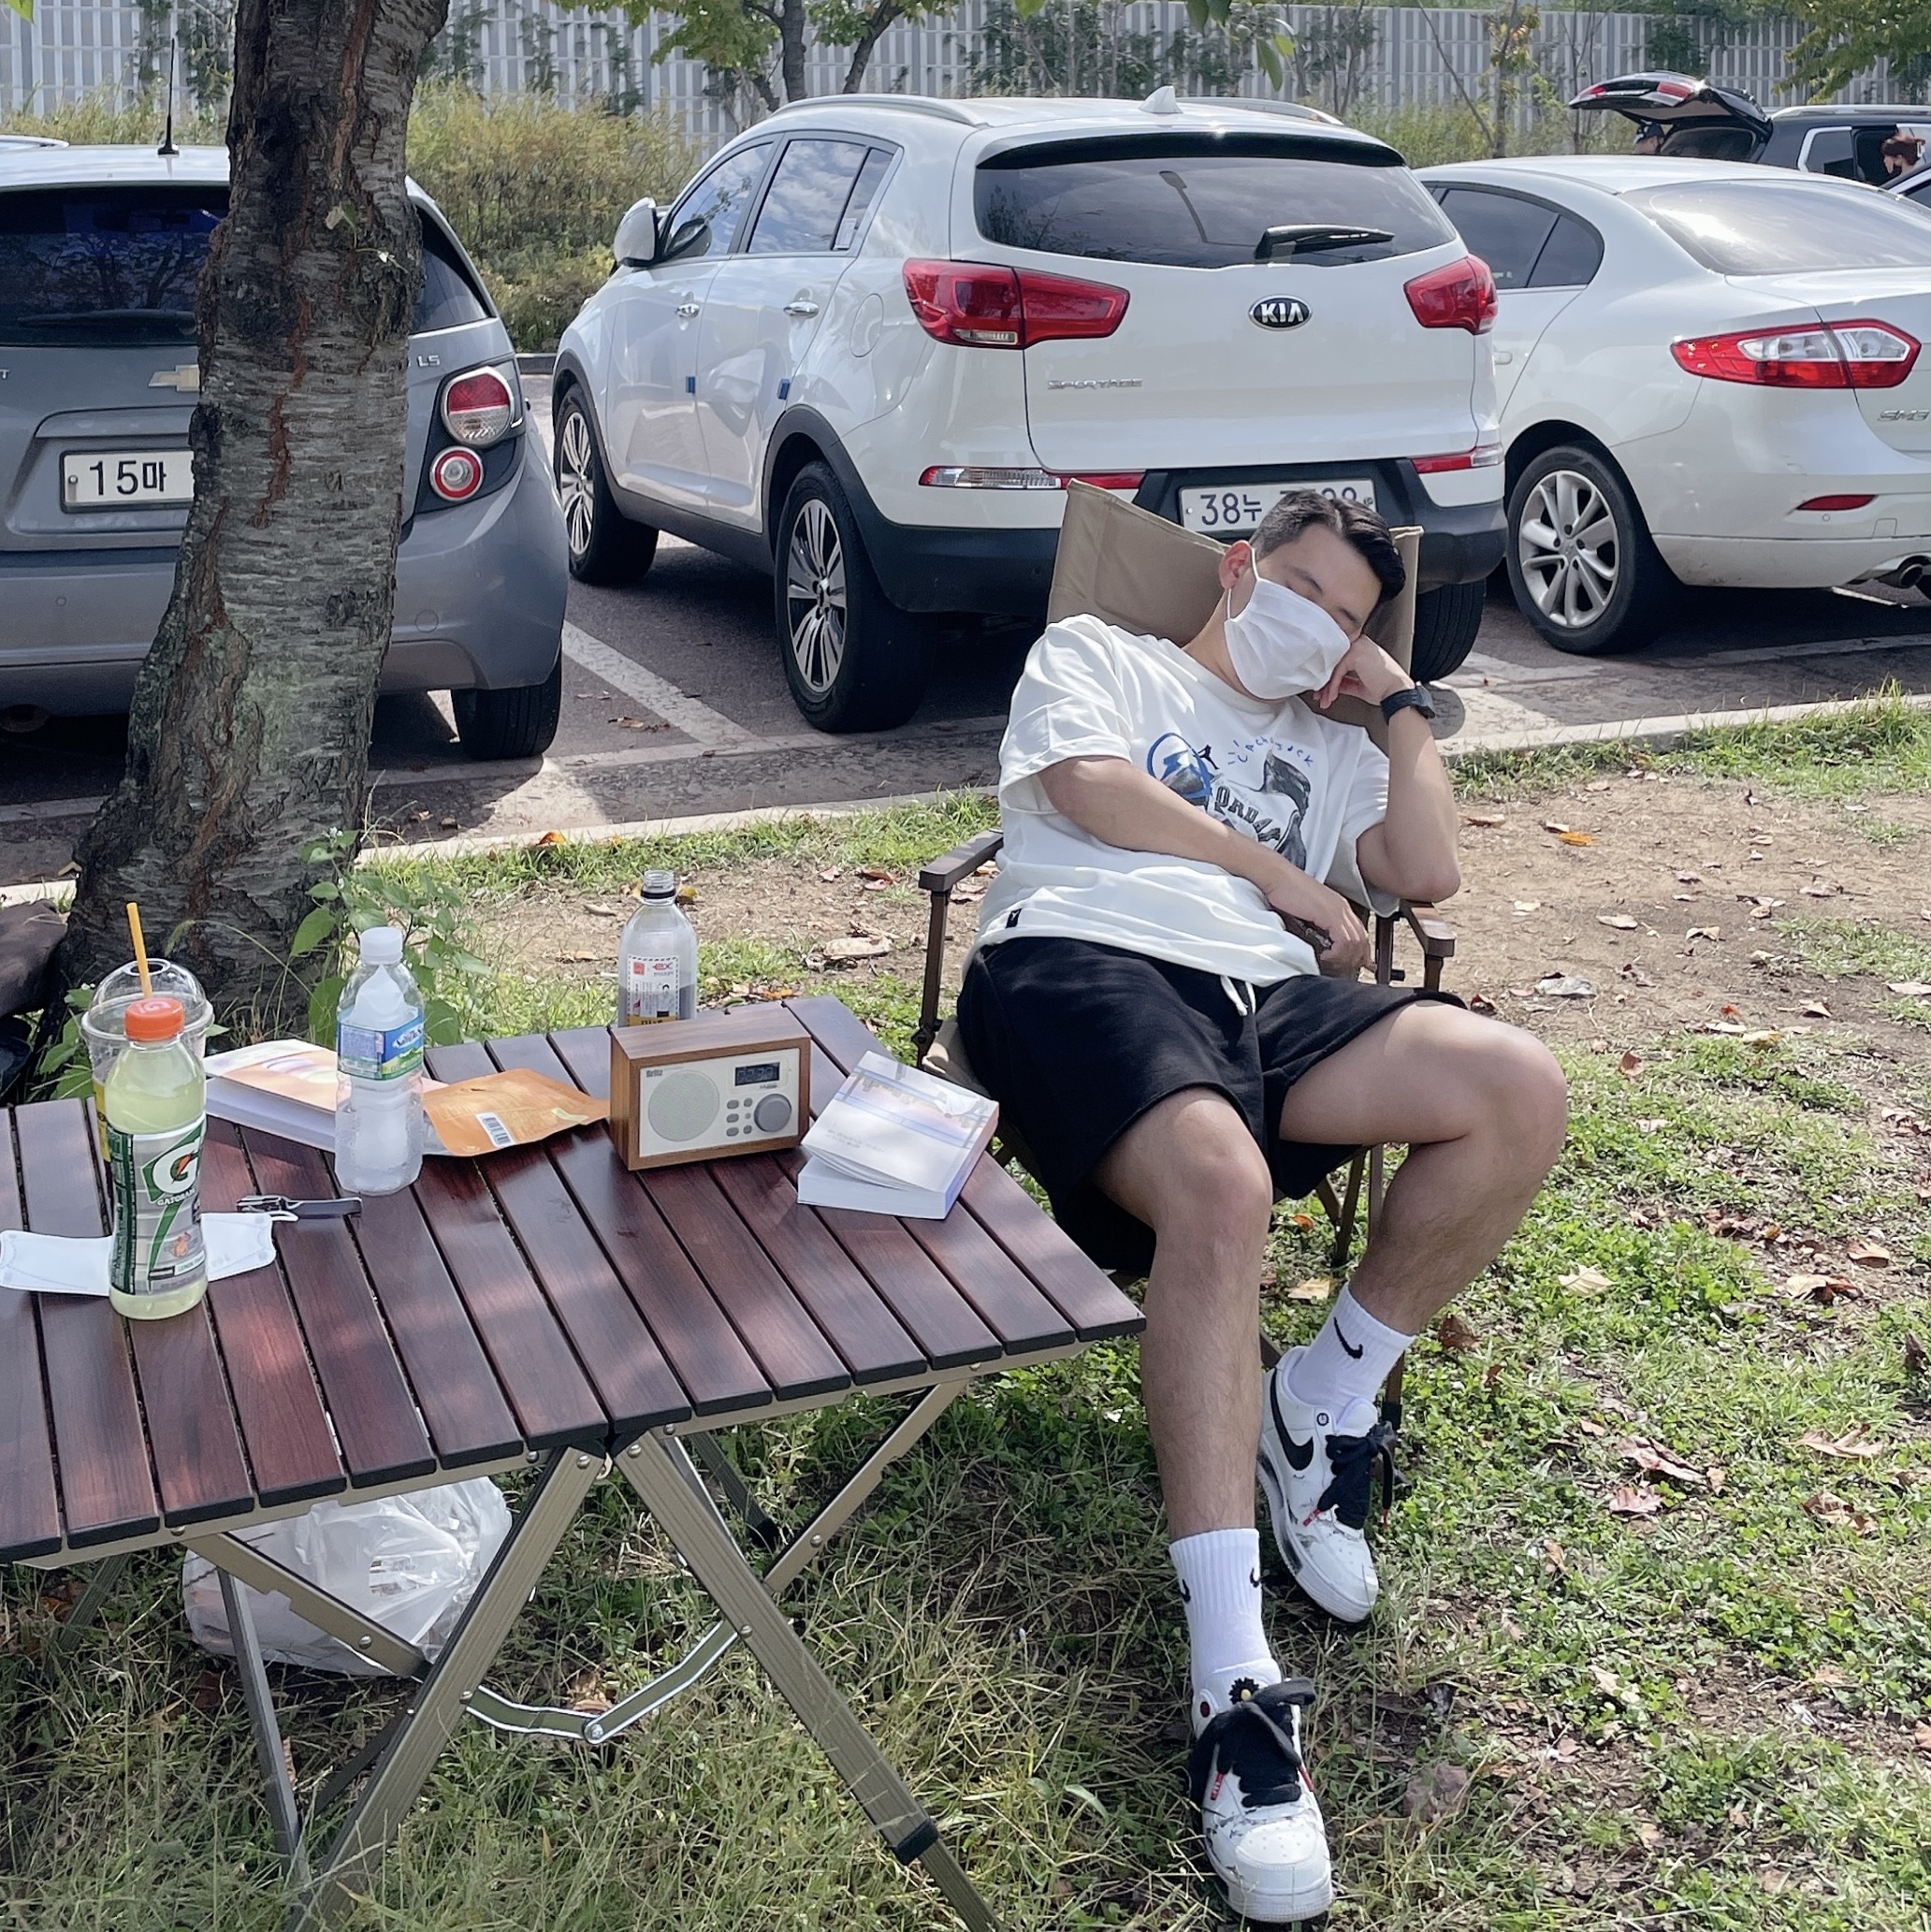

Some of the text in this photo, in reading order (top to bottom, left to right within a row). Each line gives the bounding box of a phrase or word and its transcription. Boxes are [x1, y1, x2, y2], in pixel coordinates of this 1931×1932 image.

[1260, 302, 1304, 323] KIA
[417, 355, 441, 367] LS
[89, 459, 167, 496] 15마
[1199, 492, 1263, 526] 38누
